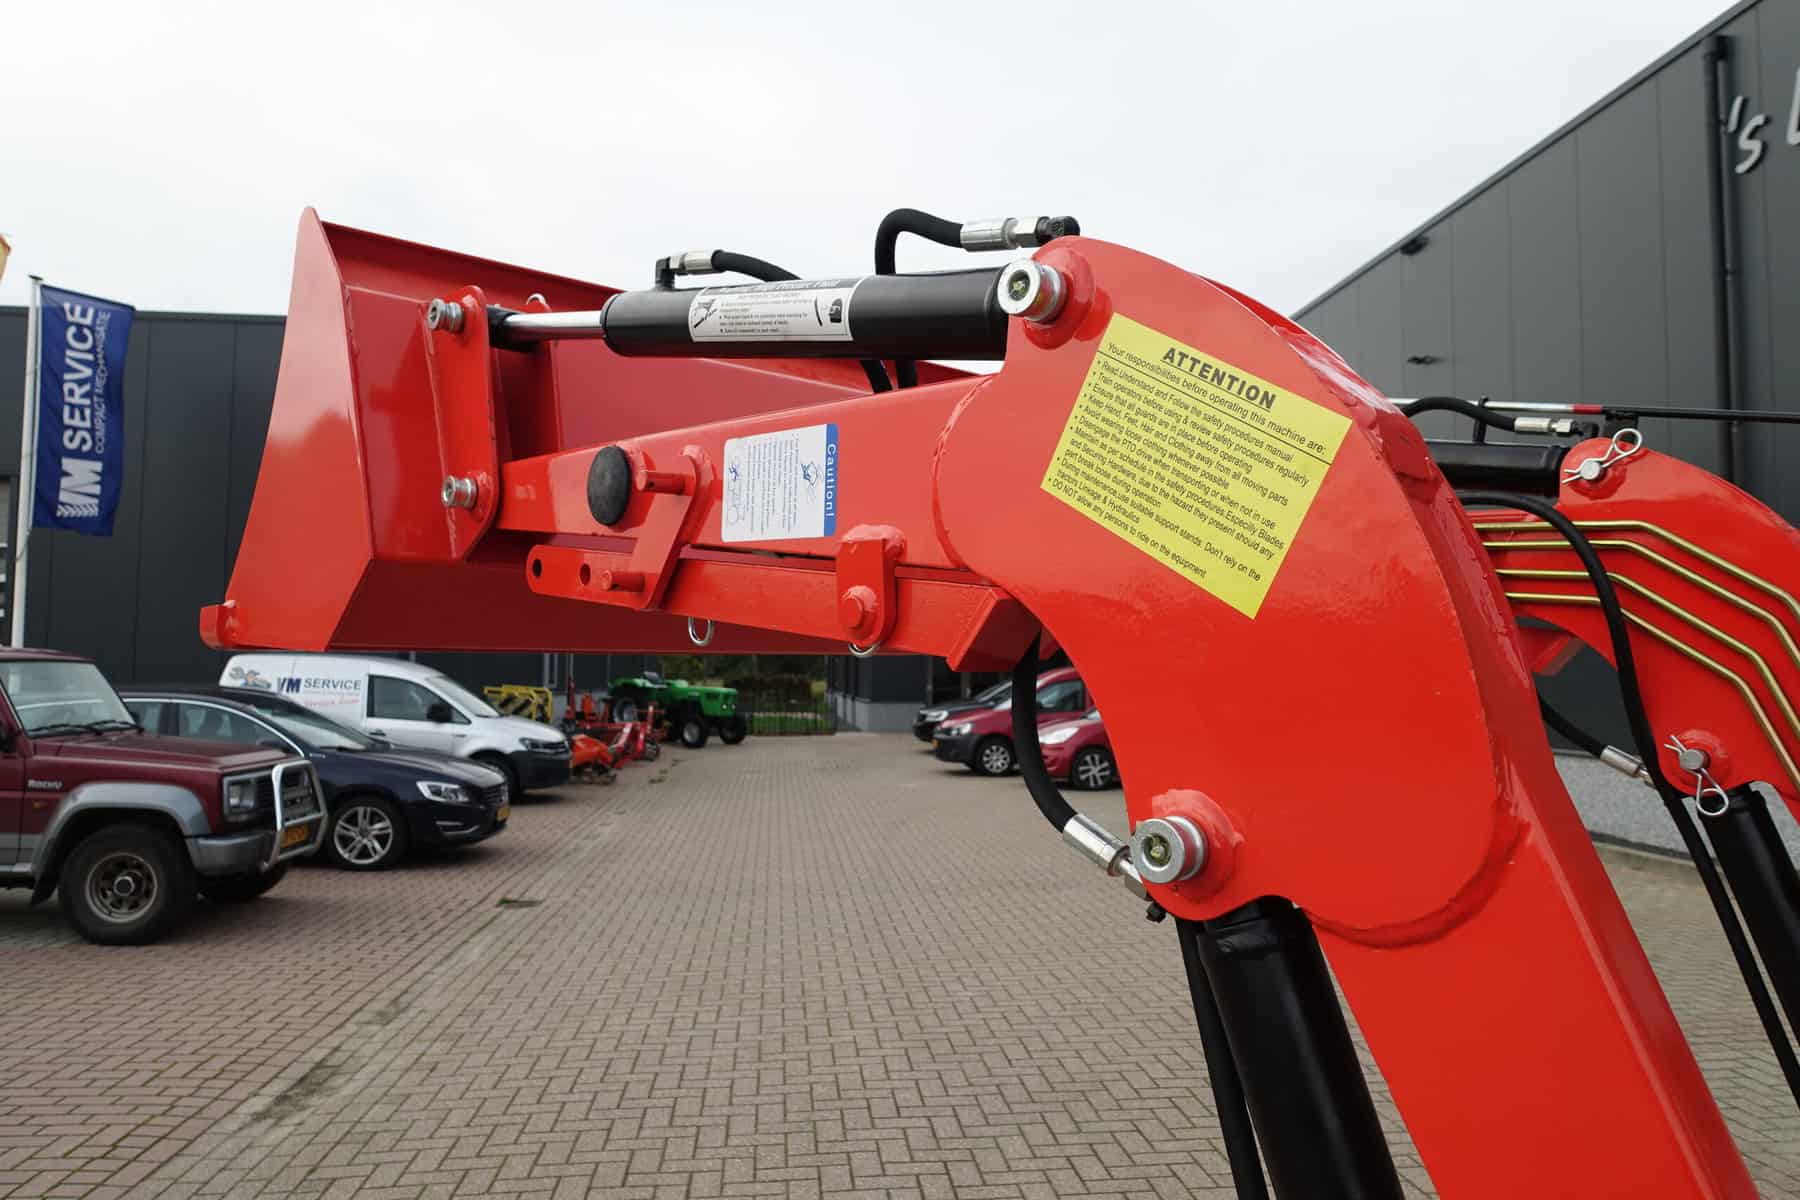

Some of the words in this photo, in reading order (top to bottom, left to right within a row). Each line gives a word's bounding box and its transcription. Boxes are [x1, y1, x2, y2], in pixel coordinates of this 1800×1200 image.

[63, 302, 95, 453] SERVICE
[1107, 342, 1126, 357] Your
[1181, 378, 1208, 398] before
[1208, 392, 1249, 419] operating
[1249, 410, 1266, 426] this
[1266, 420, 1306, 445] machine
[1163, 347, 1275, 408] ATTENTION
[1154, 388, 1169, 400] and
[1201, 412, 1224, 430] safety
[1222, 423, 1265, 449] procedures
[1264, 443, 1294, 463] manual
[1188, 420, 1211, 436] review
[1211, 431, 1234, 449] safety
[1233, 443, 1275, 469] procedures
[1274, 463, 1309, 487] regularly
[1195, 436, 1219, 455] before
[1218, 450, 1253, 474] operating
[826, 443, 836, 516] Caution!
[1120, 438, 1137, 453] PTO
[1209, 488, 1220, 499] or
[1219, 494, 1240, 509] when
[1238, 504, 1253, 517] not
[1251, 510, 1261, 522] in
[1260, 517, 1276, 530] use
[1194, 451, 1214, 468] away
[1213, 460, 1232, 476] from
[1230, 470, 1242, 481] all
[1240, 475, 1269, 497] moving
[1267, 490, 1289, 507] parts
[1198, 469, 1230, 490] possible
[1153, 513, 1180, 533] support
[1222, 554, 1238, 569] rely
[1237, 562, 1248, 574] on
[1247, 568, 1261, 581] the
[1169, 493, 1194, 513] hazard
[1192, 506, 1209, 523] they
[1207, 516, 1236, 537] present
[1234, 531, 1261, 551] should
[1258, 545, 1274, 561] any
[1257, 528, 1284, 549] Blades
[303, 679, 362, 691] SERVICE
